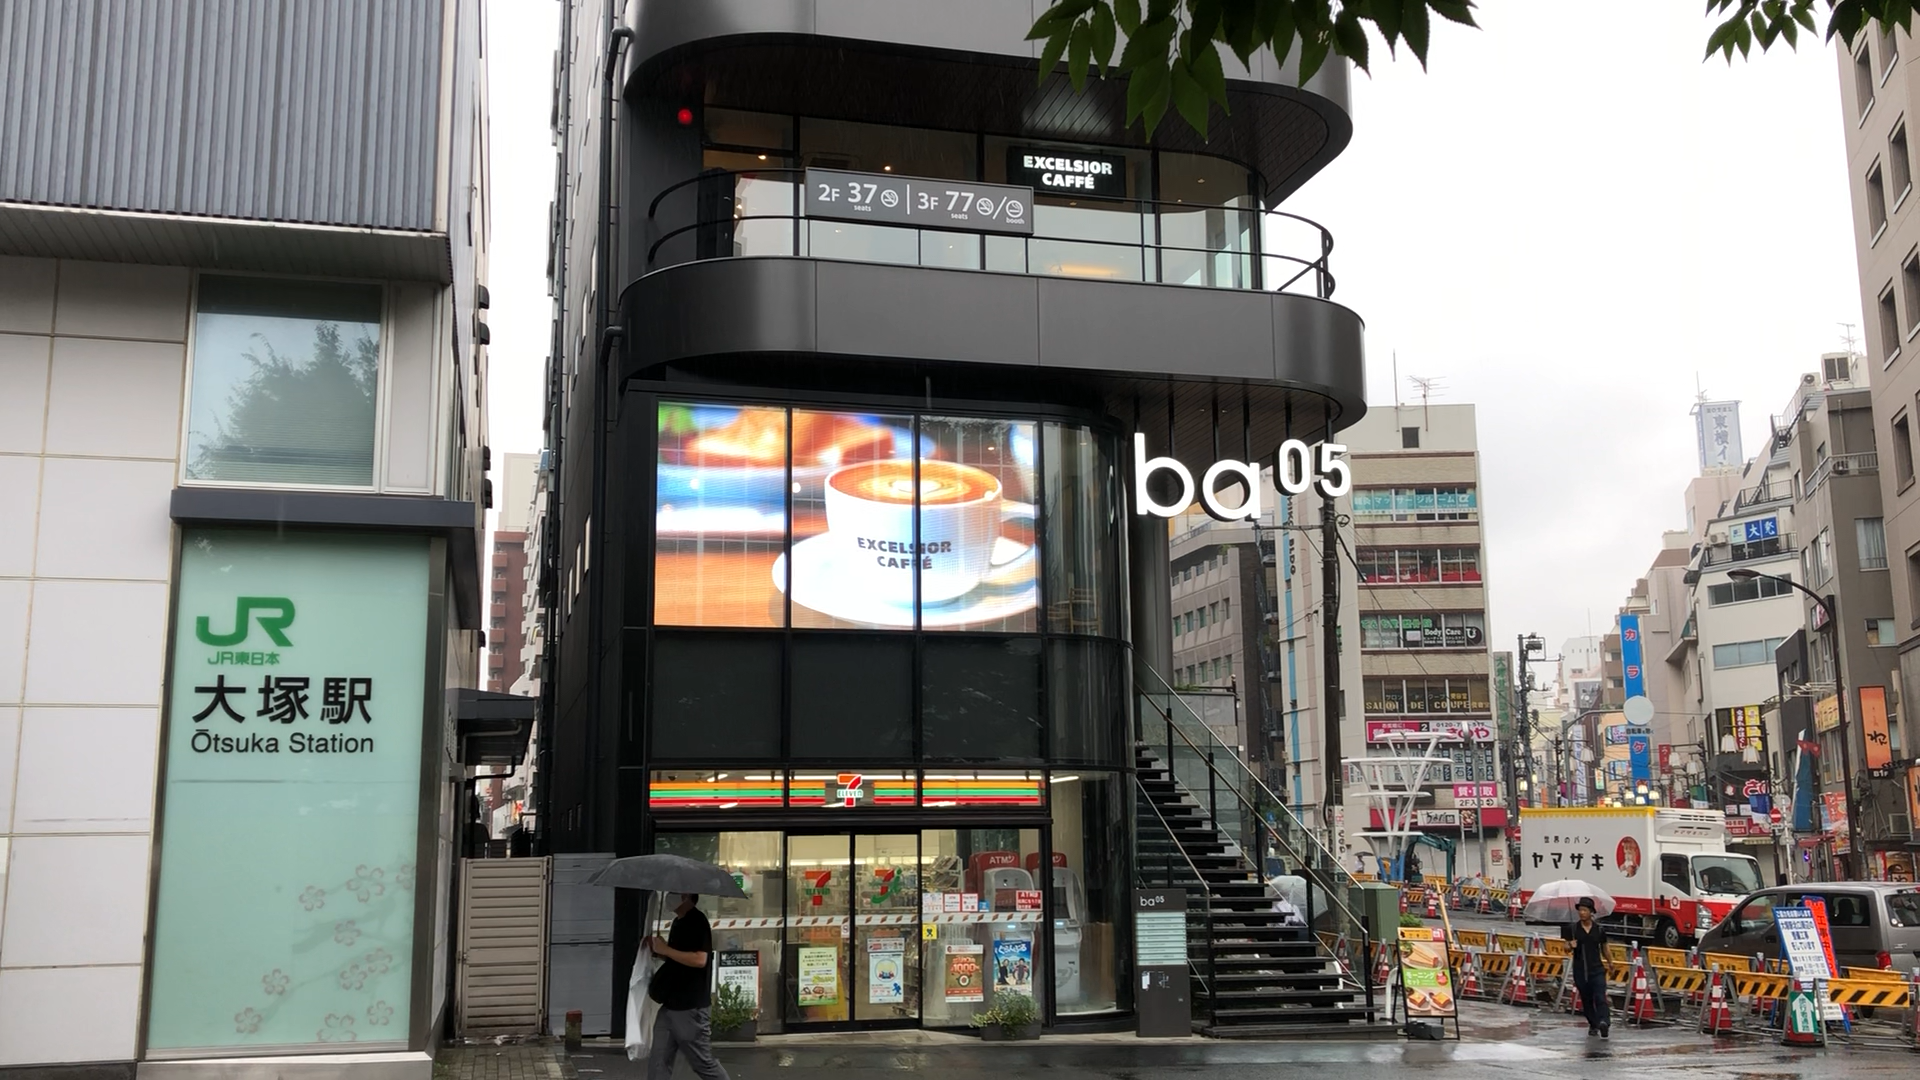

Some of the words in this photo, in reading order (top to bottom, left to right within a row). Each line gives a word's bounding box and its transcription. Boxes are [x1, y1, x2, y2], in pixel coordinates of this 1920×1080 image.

[1023, 155, 1113, 175] EXCELSIOR
[1042, 173, 1095, 190] CAFFÉ
[818, 184, 841, 202] 2F
[847, 182, 878, 204] 37
[917, 192, 939, 211] 3F
[945, 190, 975, 213] 77
[853, 203, 872, 213] seats
[950, 211, 969, 221] seats
[1005, 216, 1025, 226] booth
[1713, 415, 1729, 464] 東横イ
[196, 597, 296, 647] JR
[207, 651, 281, 666] JR東日本
[192, 674, 373, 724] 大塚駅
[1421, 723, 1429, 732] 2
[191, 729, 280, 753] Ōtsuka
[289, 732, 374, 753] Station
[1544, 836, 1590, 844] 世界のパン
[989, 856, 1008, 864] ATM
[1532, 852, 1604, 870] ヤマザキ
